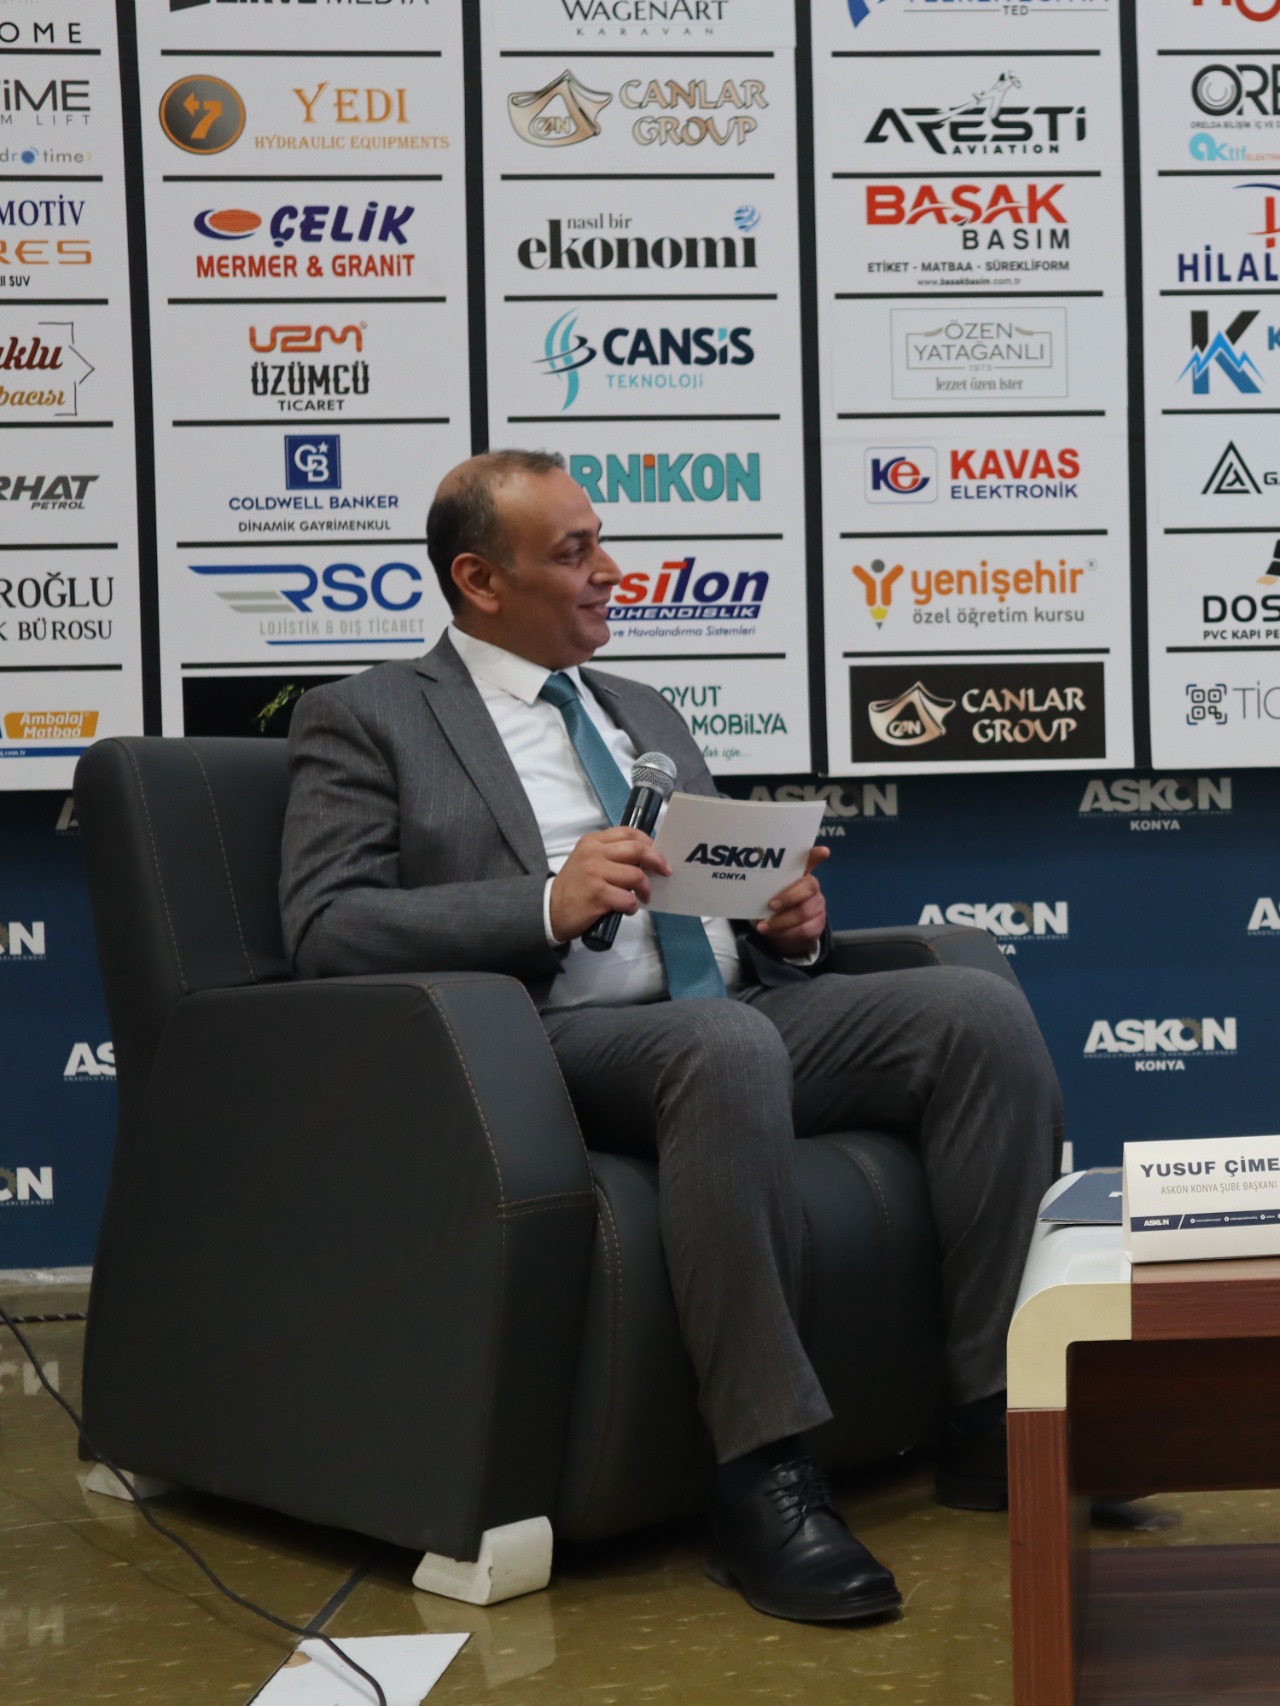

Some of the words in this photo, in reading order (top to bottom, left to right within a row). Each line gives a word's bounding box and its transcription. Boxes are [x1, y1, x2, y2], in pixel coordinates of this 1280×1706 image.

[1003, 5, 1029, 16] TED
[577, 27, 714, 36] KARAVAN
[0, 79, 91, 111] iME
[619, 79, 769, 109] CANLAR
[36, 114, 92, 126] LIFT
[632, 116, 758, 146] GROUP
[255, 135, 345, 149] HYDRAULIC
[350, 135, 450, 150] EQUIPMENTS
[952, 144, 1060, 154] AVIATION
[567, 214, 603, 230] nasıl
[609, 214, 632, 229] bir
[517, 216, 758, 270] ekonomi
[963, 228, 1069, 250] BASIM
[196, 256, 298, 278] MERMER
[306, 256, 324, 277] &
[868, 260, 909, 273] ETİKET
[921, 262, 973, 272] MATBAA
[1178, 245, 1278, 282] HİLAL
[9, 275, 31, 287] SUV
[944, 320, 1013, 339] ÖZEN
[914, 342, 1044, 361] YATAĞANLI
[250, 361, 370, 395] ÜZÜMCÜ
[936, 376, 967, 390] lezzet
[970, 377, 996, 390] özen
[950, 448, 1080, 480] KAVAS
[951, 481, 1078, 499] ELEKTRONİK
[31, 501, 86, 510] PETROL
[229, 497, 324, 511] COLDWELL
[330, 495, 399, 510] BANKER
[238, 519, 296, 532] DİNAMİK
[299, 518, 391, 532] GAYRİMENKUL
[240, 562, 423, 613] RSC
[612, 557, 770, 604] silon
[911, 559, 1084, 605] yenişehir
[609, 604, 755, 619] ÜHENDİSLİK
[913, 608, 950, 624] özel
[957, 606, 1027, 627] öğretim
[1034, 607, 1084, 622] kursu
[18, 618, 112, 641] BÜROSU
[340, 620, 362, 637] DIŞ
[369, 617, 424, 634] TİCARET
[706, 626, 756, 636] Sistemleri
[1203, 630, 1227, 640] PVC
[1232, 629, 1261, 640] KAPI
[660, 685, 721, 708] OYUT
[962, 687, 1086, 713] CANLAR
[20, 712, 84, 726] Ambalaj
[972, 717, 1077, 743] GROUP
[1130, 820, 1180, 832] KONYA
[684, 842, 786, 869] ASKON
[712, 871, 746, 881] KONYA
[1083, 1017, 1237, 1053] ASKON
[1135, 1060, 1185, 1072] KONYA
[1140, 1160, 1216, 1178] YUSUF
[1161, 1184, 1188, 1195] ASKON
[1191, 1183, 1218, 1194] KONYA
[1220, 1181, 1240, 1195] ŞUBE
[1243, 1180, 1277, 1194] BAŞKANI
